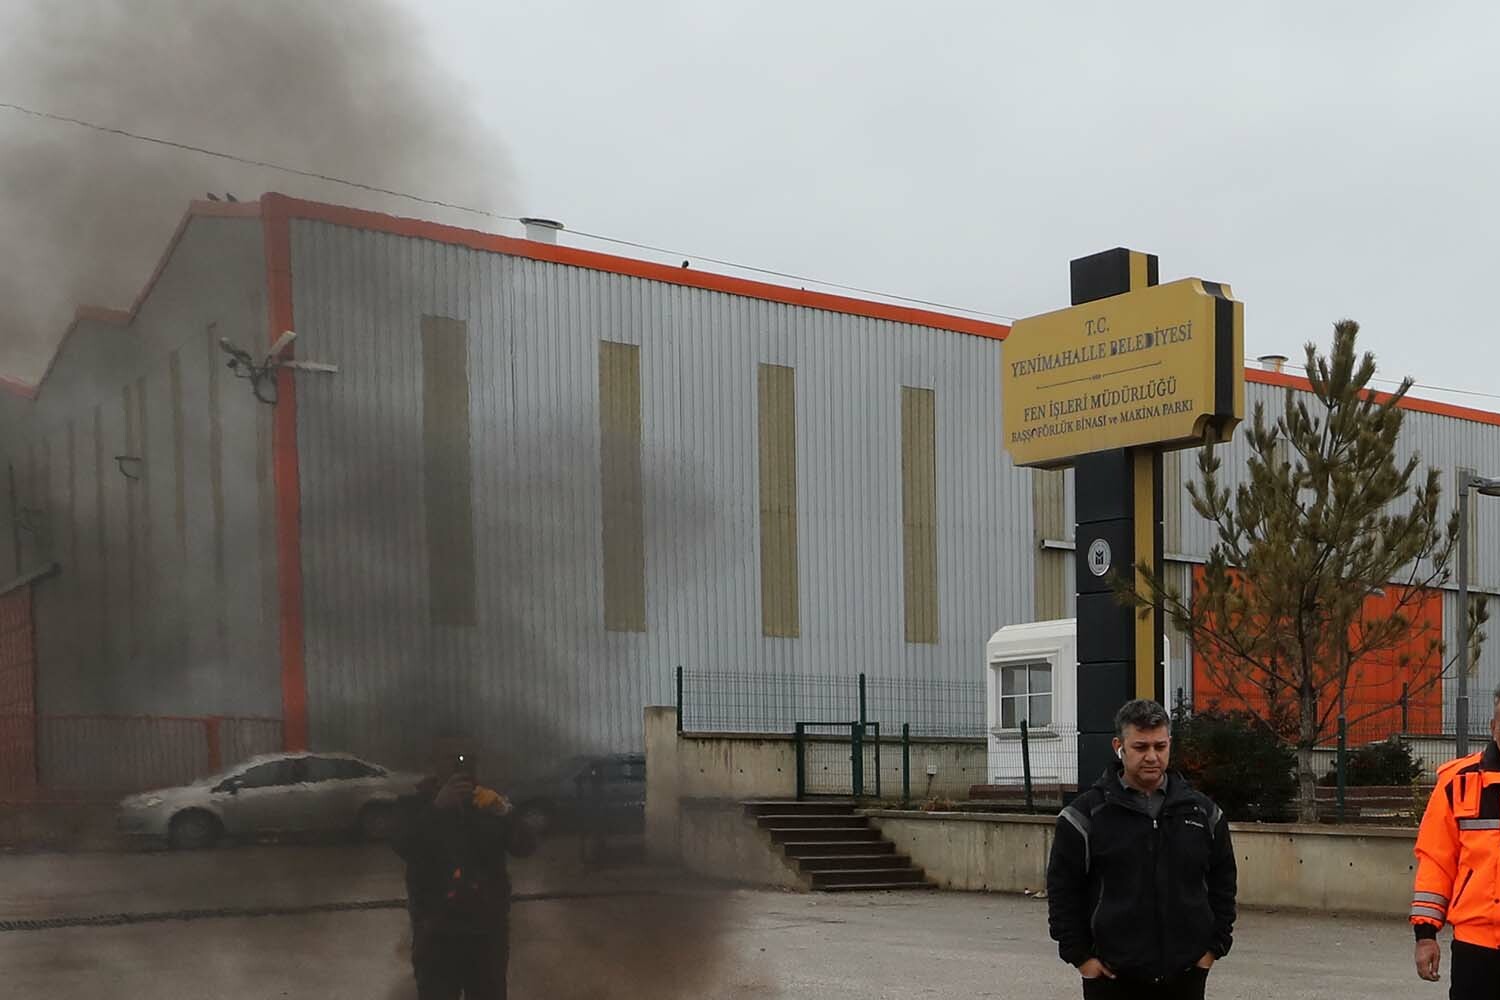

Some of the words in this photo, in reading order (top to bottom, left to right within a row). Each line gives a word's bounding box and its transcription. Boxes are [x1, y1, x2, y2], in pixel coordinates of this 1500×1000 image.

[1085, 317, 1110, 337] T.C.
[1011, 343, 1106, 378] YENİMAHALLE
[1110, 320, 1193, 357] BELEDİYESİ
[1024, 404, 1046, 422] FEN
[1049, 393, 1088, 420] İŞLERİ
[1090, 376, 1176, 409] MÜDÜRLÜĞÜ
[1075, 415, 1106, 432] BİNASI
[1108, 416, 1118, 425] ve
[1120, 404, 1161, 423] MAKİNA
[1162, 399, 1193, 416] PARKI
